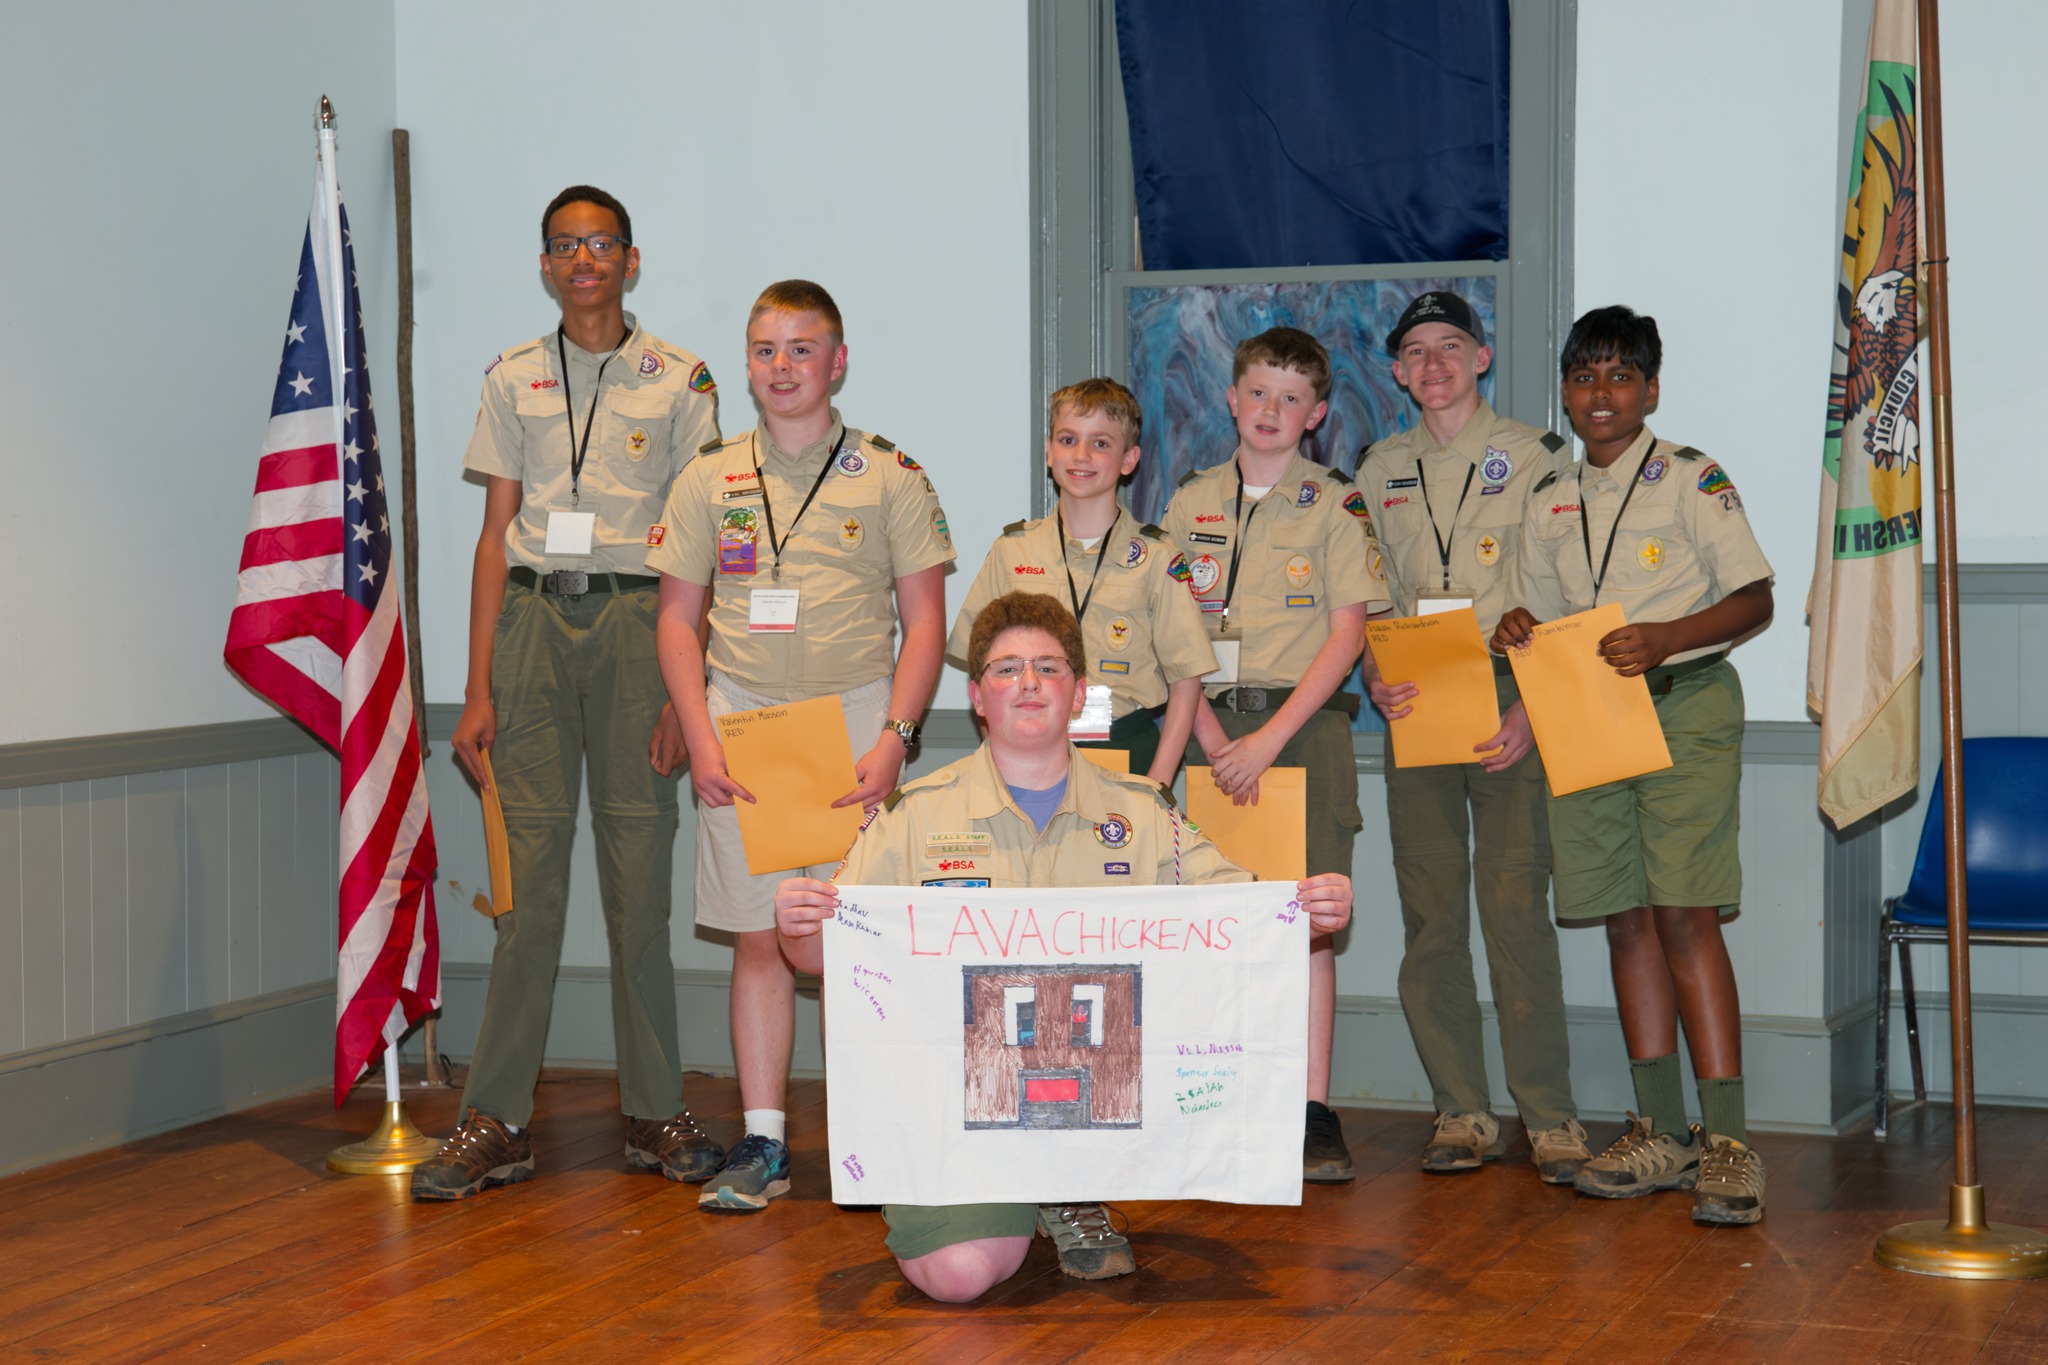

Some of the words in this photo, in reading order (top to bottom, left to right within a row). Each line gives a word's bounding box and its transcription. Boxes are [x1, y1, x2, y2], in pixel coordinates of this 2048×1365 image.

[541, 379, 559, 389] BSA
[737, 471, 758, 482] BSA
[1391, 495, 1409, 506] BSA
[1562, 503, 1582, 513] BSA
[1206, 514, 1226, 523] BSA
[1025, 565, 1046, 575] BSA
[1371, 634, 1389, 643] RED
[1513, 647, 1531, 659] RED
[720, 714, 755, 727] Valentin
[757, 709, 788, 720] Masson
[724, 728, 745, 738] RED
[952, 860, 976, 870] BSA
